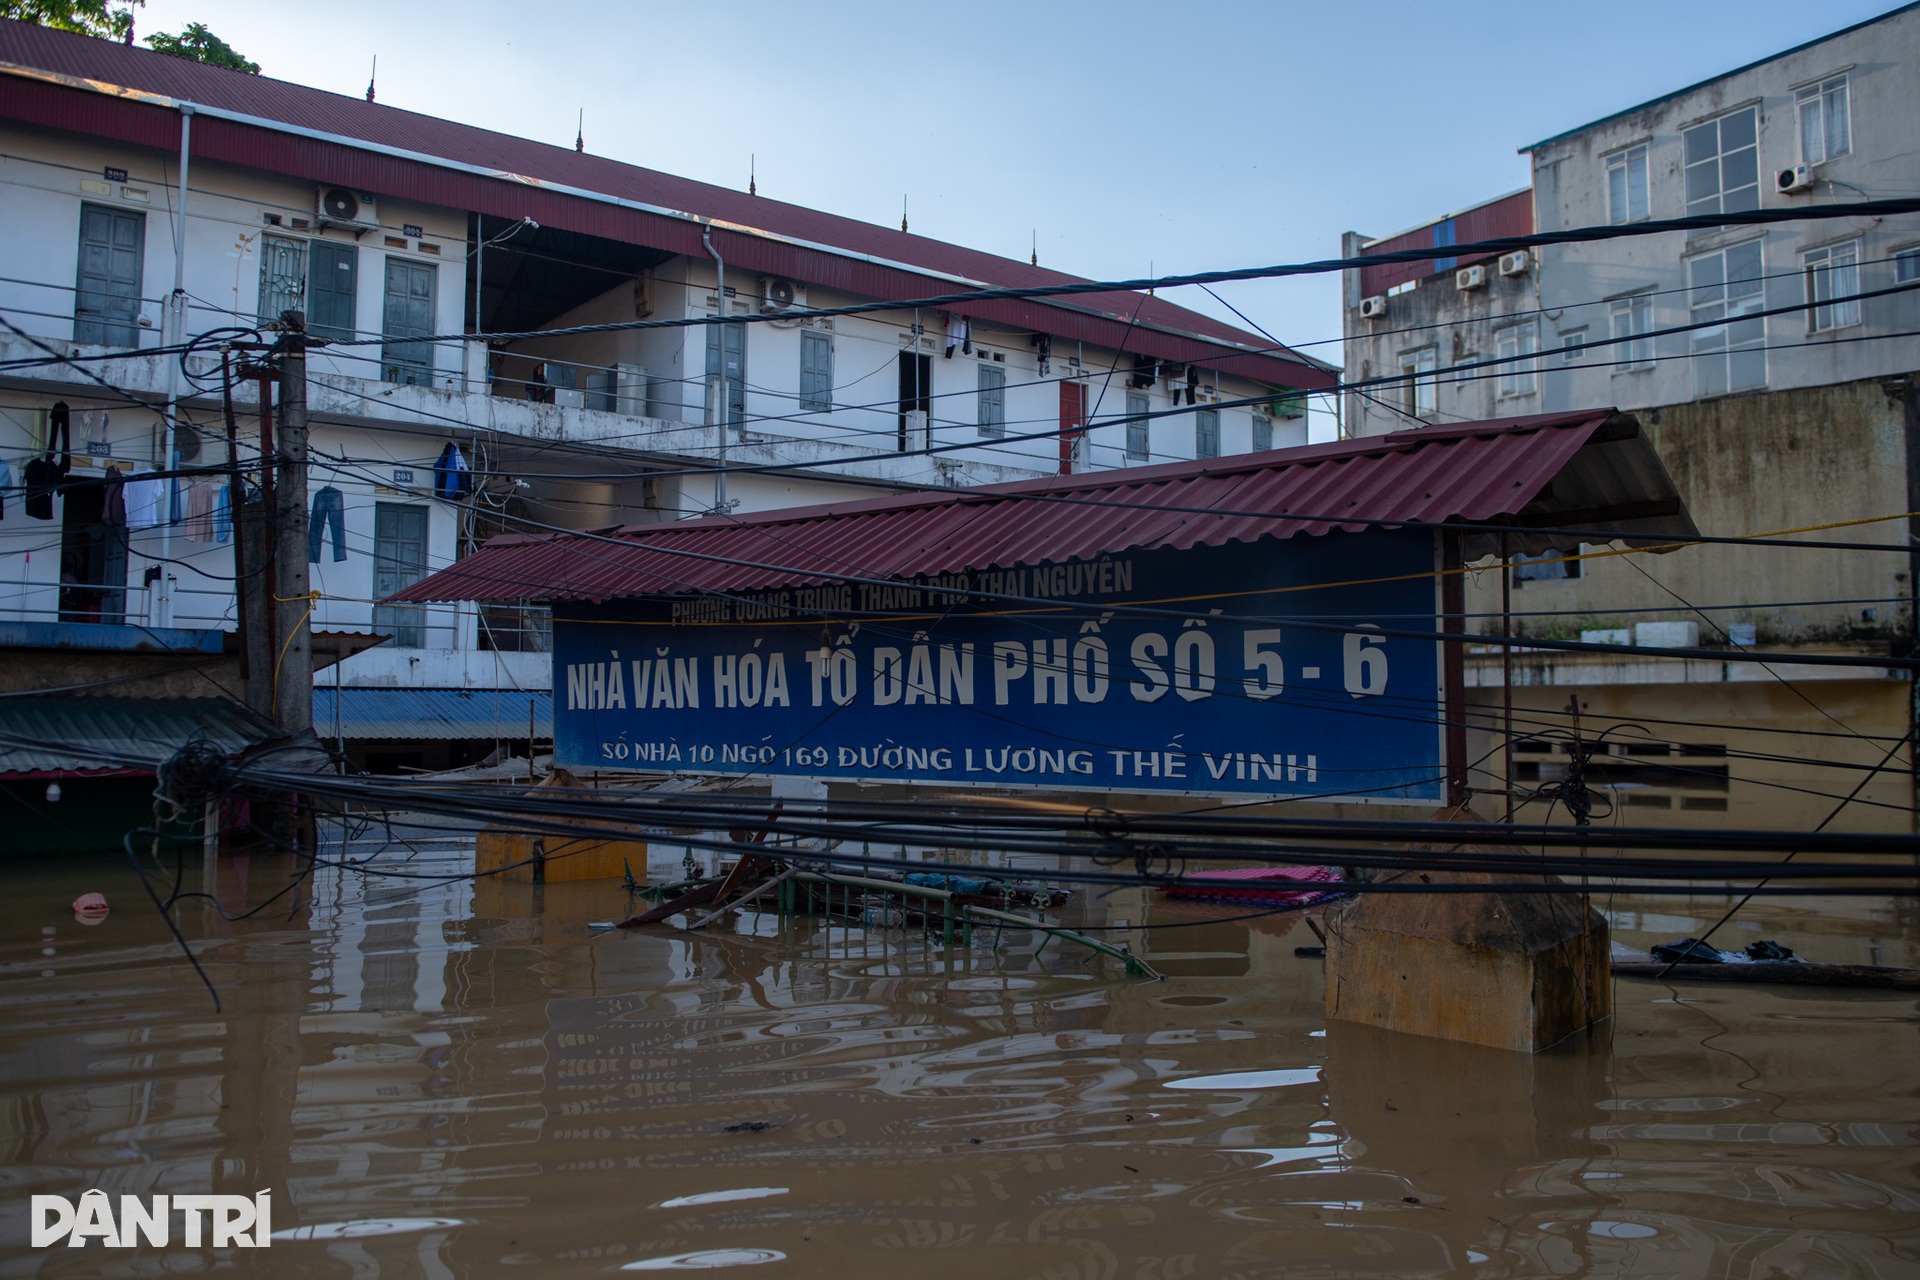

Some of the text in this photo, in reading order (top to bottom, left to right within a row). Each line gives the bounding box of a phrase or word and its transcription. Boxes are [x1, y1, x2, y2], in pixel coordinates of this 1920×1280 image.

[90, 444, 109, 455] 203
[736, 591, 790, 623] QUANG
[795, 585, 852, 616] TRUNG
[1033, 556, 1133, 599] NGUYÊN
[567, 650, 626, 711] NHÀ
[633, 647, 699, 710] VĂN
[713, 639, 790, 709] HÓA
[805, 622, 860, 707] TỔ
[873, 630, 975, 706] DÂN
[993, 612, 1115, 705] PHỐ
[1130, 609, 1224, 703] SỐ
[1243, 628, 1284, 701] 5
[1343, 623, 1389, 700] 6
[602, 730, 629, 760] SỐ
[634, 736, 682, 762] NHÀ
[688, 743, 715, 763] 10
[781, 745, 829, 768] 169
[837, 738, 953, 771] ĐƯỜNG
[965, 744, 1094, 776] LƯƠNG
[1107, 733, 1188, 779] THẾ
[1202, 751, 1318, 783] VINH
